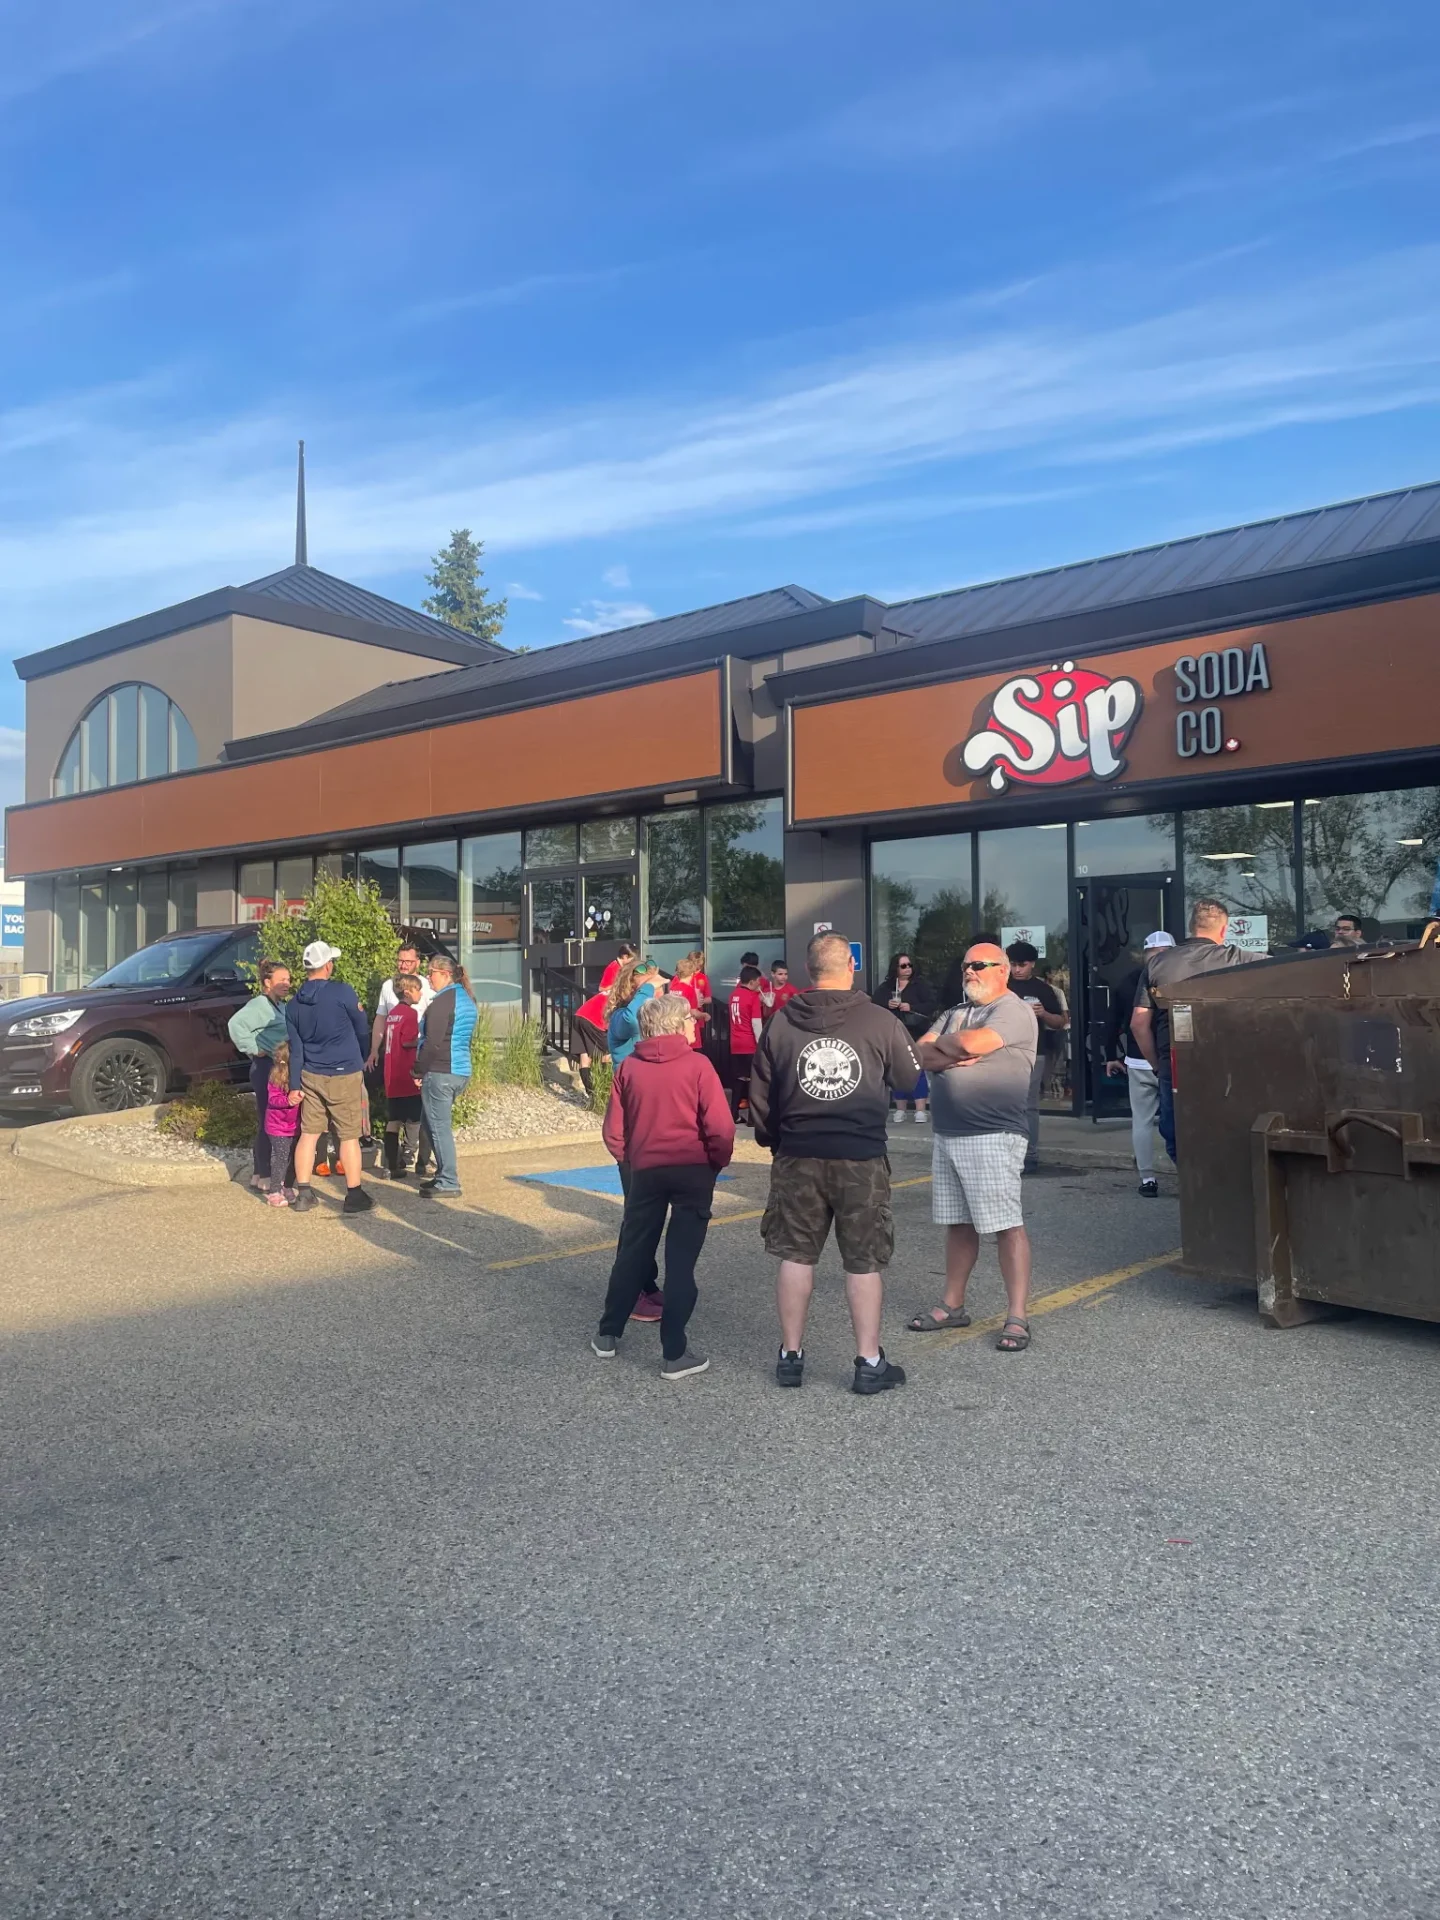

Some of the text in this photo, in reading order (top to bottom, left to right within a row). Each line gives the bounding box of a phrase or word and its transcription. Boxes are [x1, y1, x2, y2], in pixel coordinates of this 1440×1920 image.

[1175, 642, 1272, 703] SODA
[962, 671, 1139, 780] Sip
[1077, 864, 1088, 874] 10
[1240, 938, 1267, 947] OPEN
[824, 1078, 857, 1098] FESTIVAL
